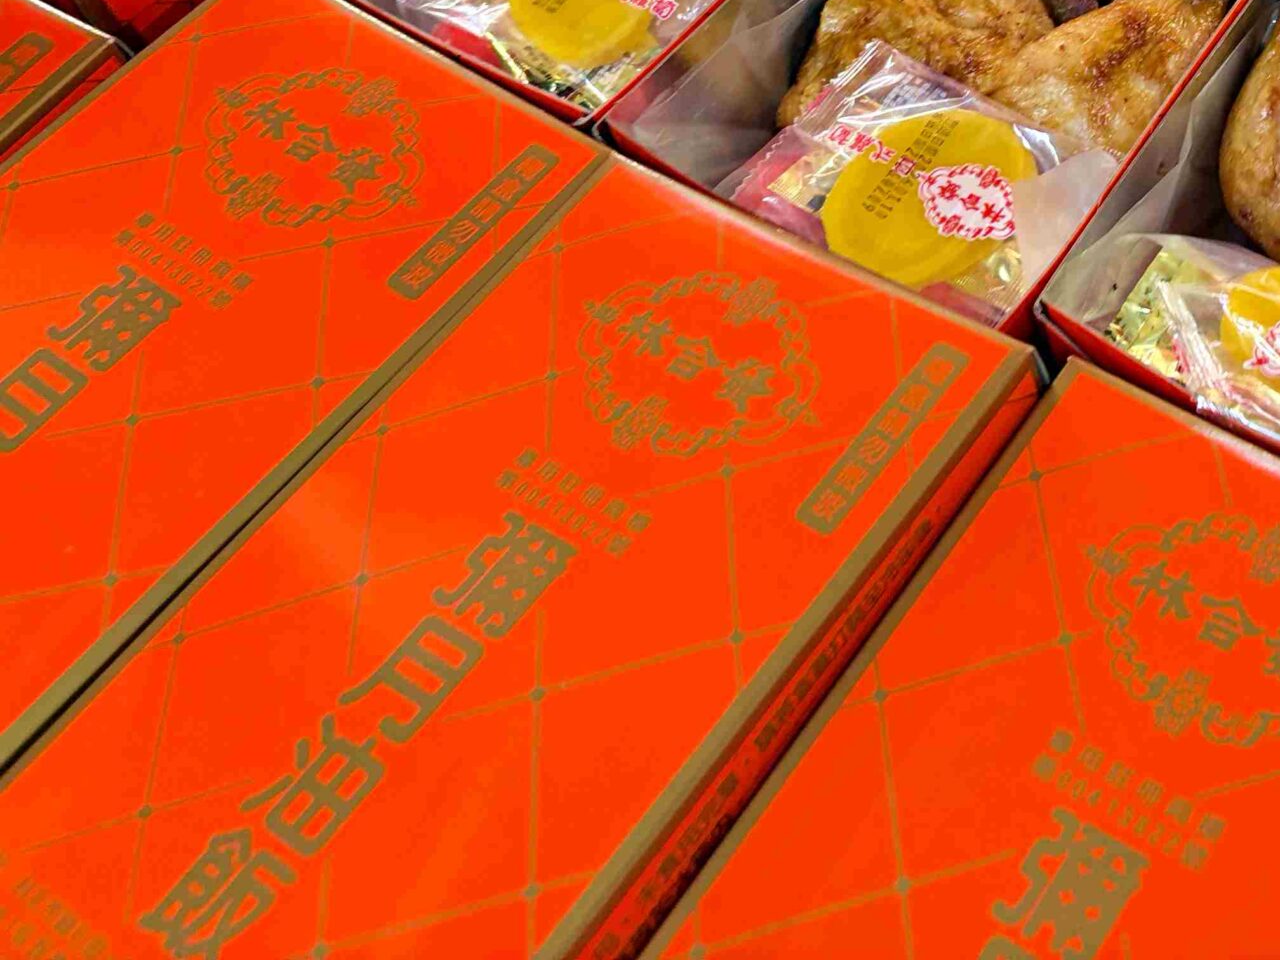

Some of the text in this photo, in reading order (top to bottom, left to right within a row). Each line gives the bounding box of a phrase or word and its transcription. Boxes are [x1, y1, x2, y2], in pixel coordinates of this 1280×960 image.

[241, 99, 386, 192] 林合發
[616, 311, 778, 412] 林合發
